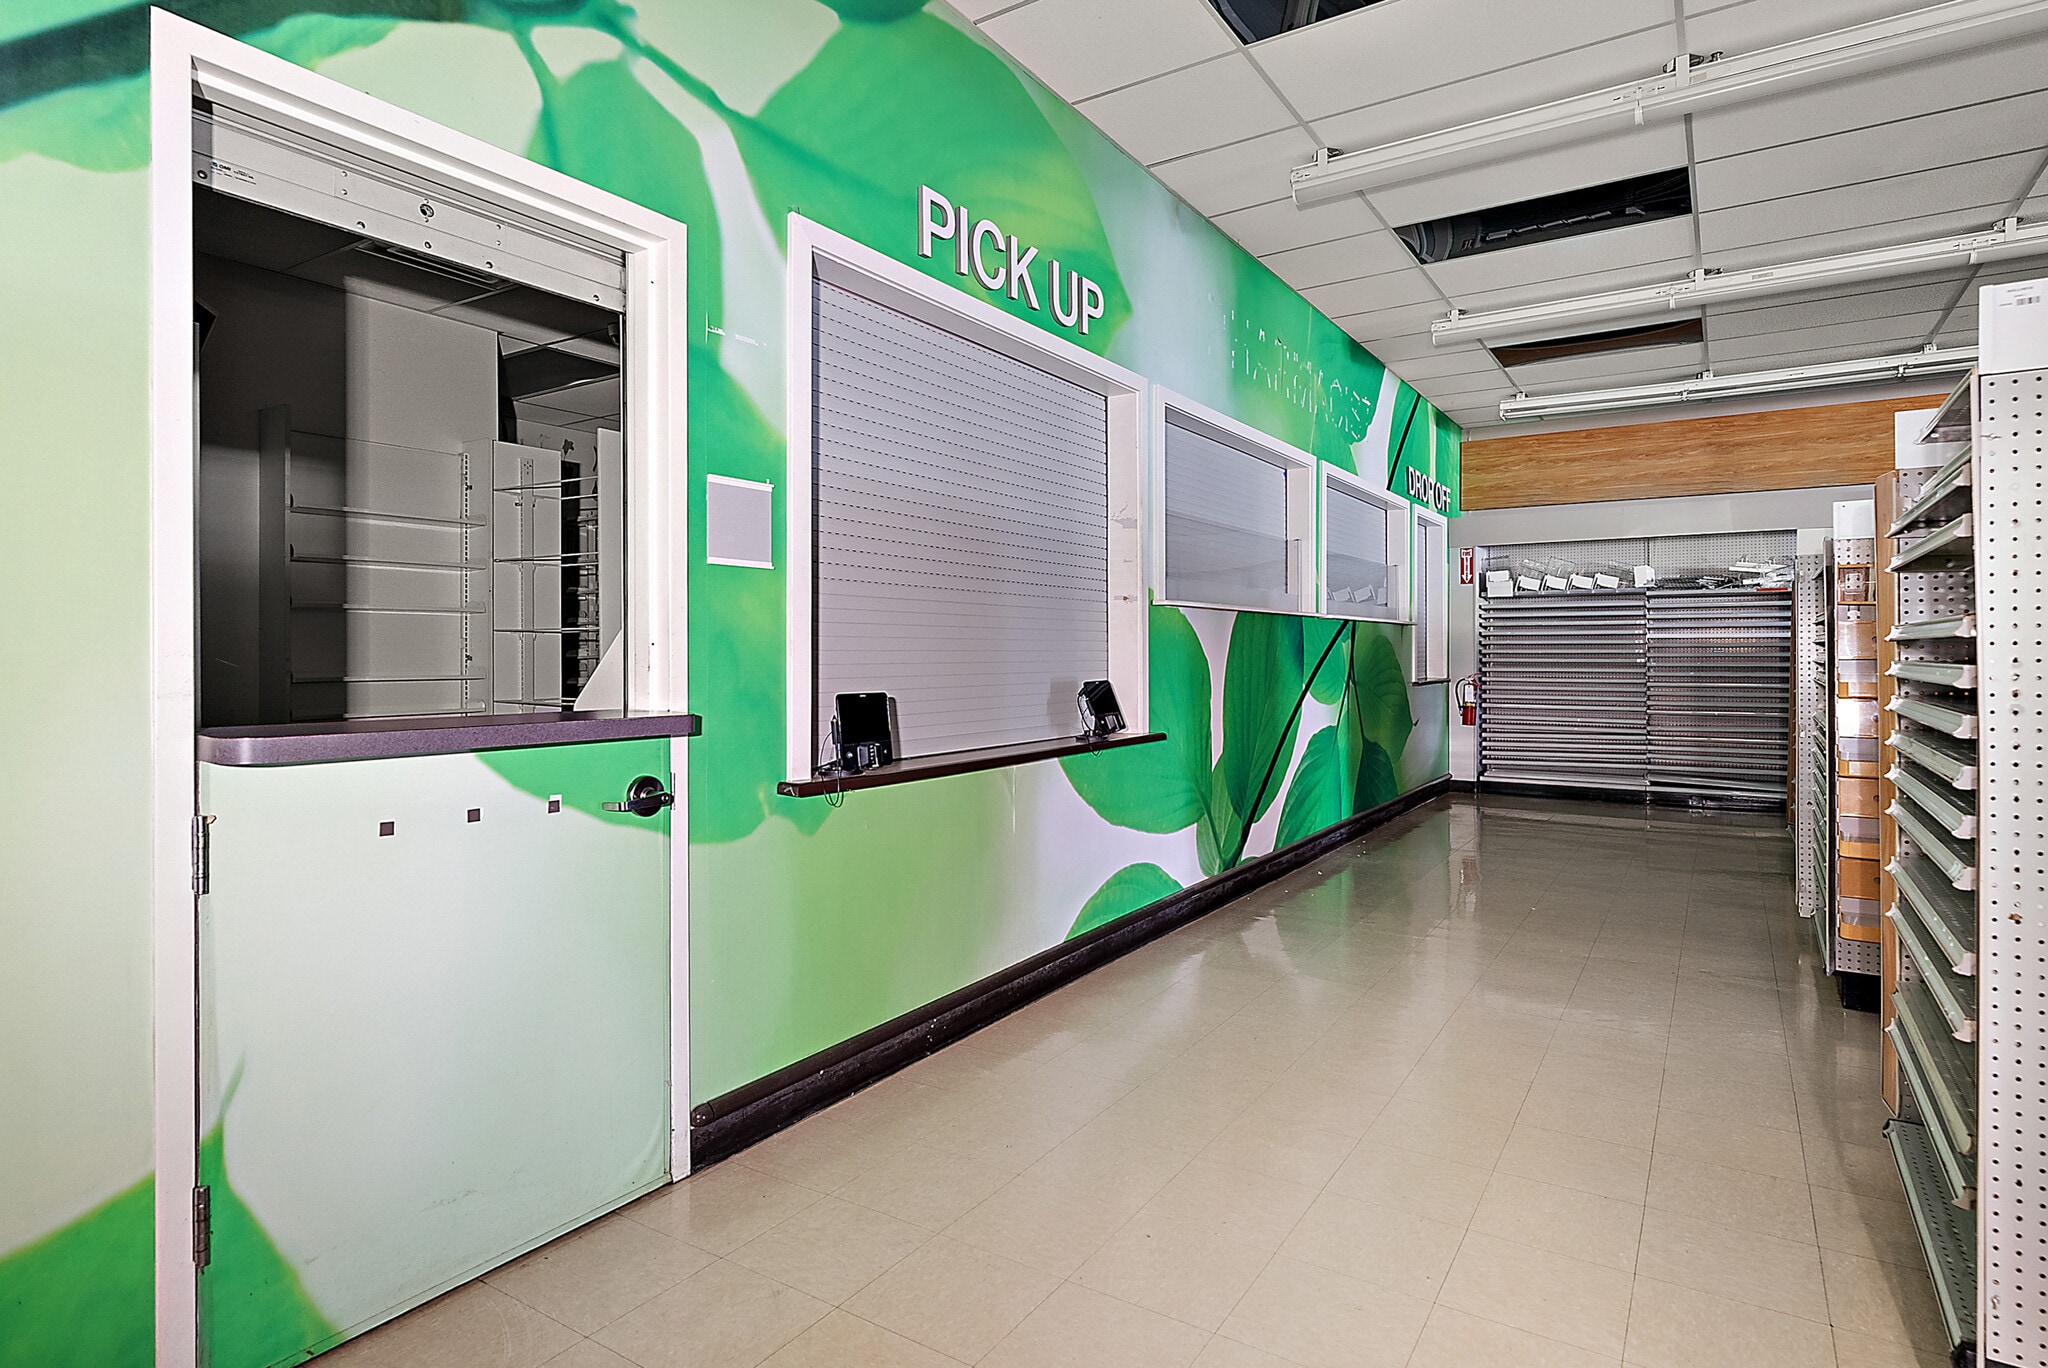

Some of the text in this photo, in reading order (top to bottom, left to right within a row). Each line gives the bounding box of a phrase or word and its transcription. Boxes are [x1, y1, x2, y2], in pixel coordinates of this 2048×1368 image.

[918, 184, 1105, 335] PICK UP
[1407, 465, 1451, 512] DROP OFF
